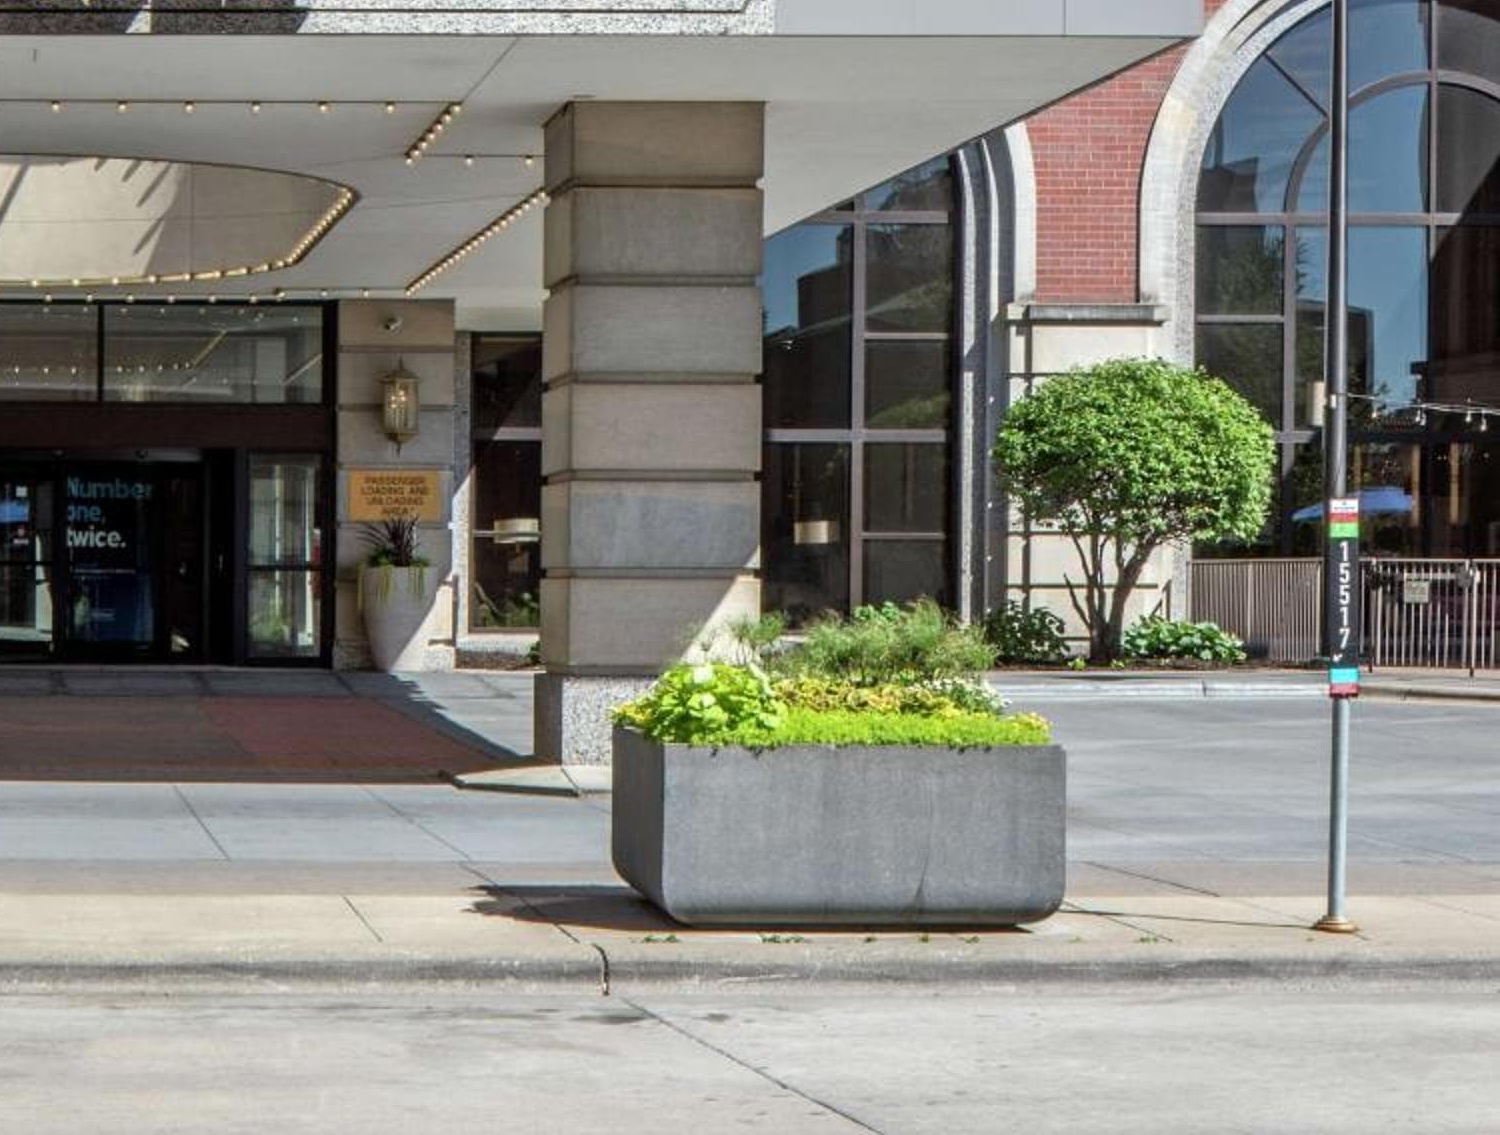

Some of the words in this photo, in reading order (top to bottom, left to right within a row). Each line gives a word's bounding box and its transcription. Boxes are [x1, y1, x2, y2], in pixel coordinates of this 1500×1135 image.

[67, 476, 153, 499] Number
[360, 486, 405, 495] LOADING
[409, 486, 429, 495] AND
[364, 476, 425, 485] PASSENGER
[67, 525, 128, 549] twice.
[1339, 540, 1351, 650] 15517
